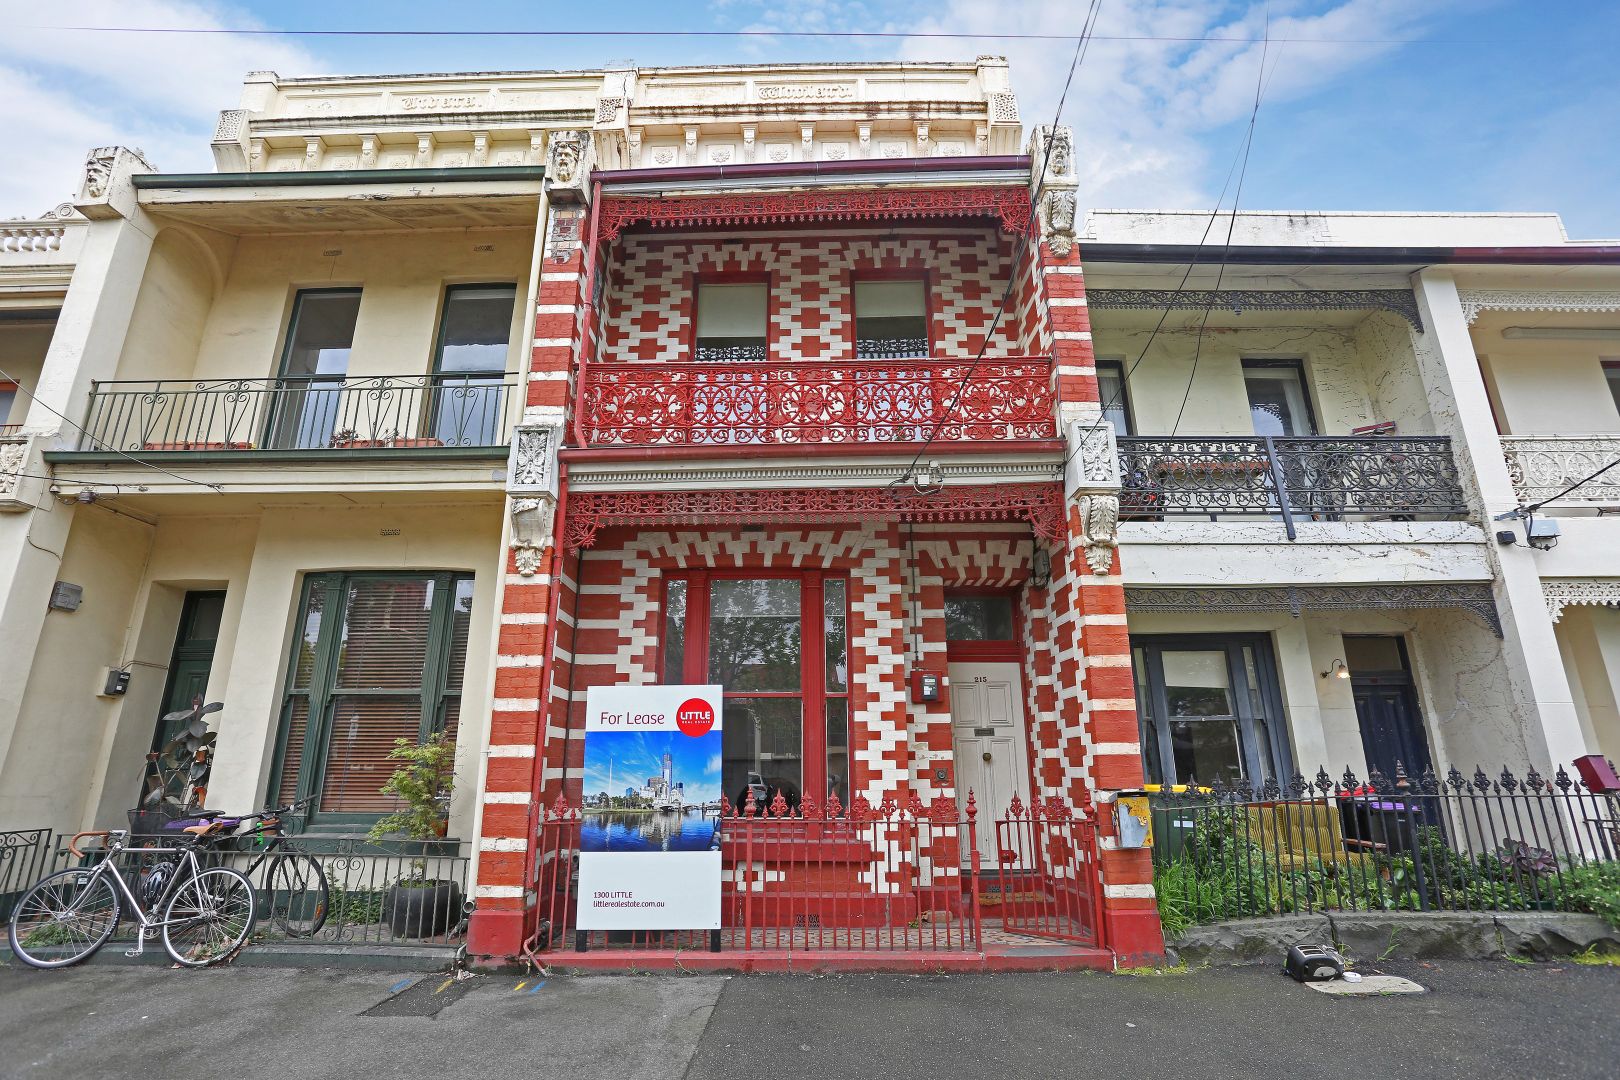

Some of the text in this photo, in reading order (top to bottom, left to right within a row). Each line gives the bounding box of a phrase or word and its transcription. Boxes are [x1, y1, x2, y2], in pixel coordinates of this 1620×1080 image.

[600, 711, 665, 725] For Lease
[680, 711, 711, 720] LITTLE
[593, 891, 633, 899] 1300 LITTLE
[593, 900, 665, 908] littlerealestate.com.au
